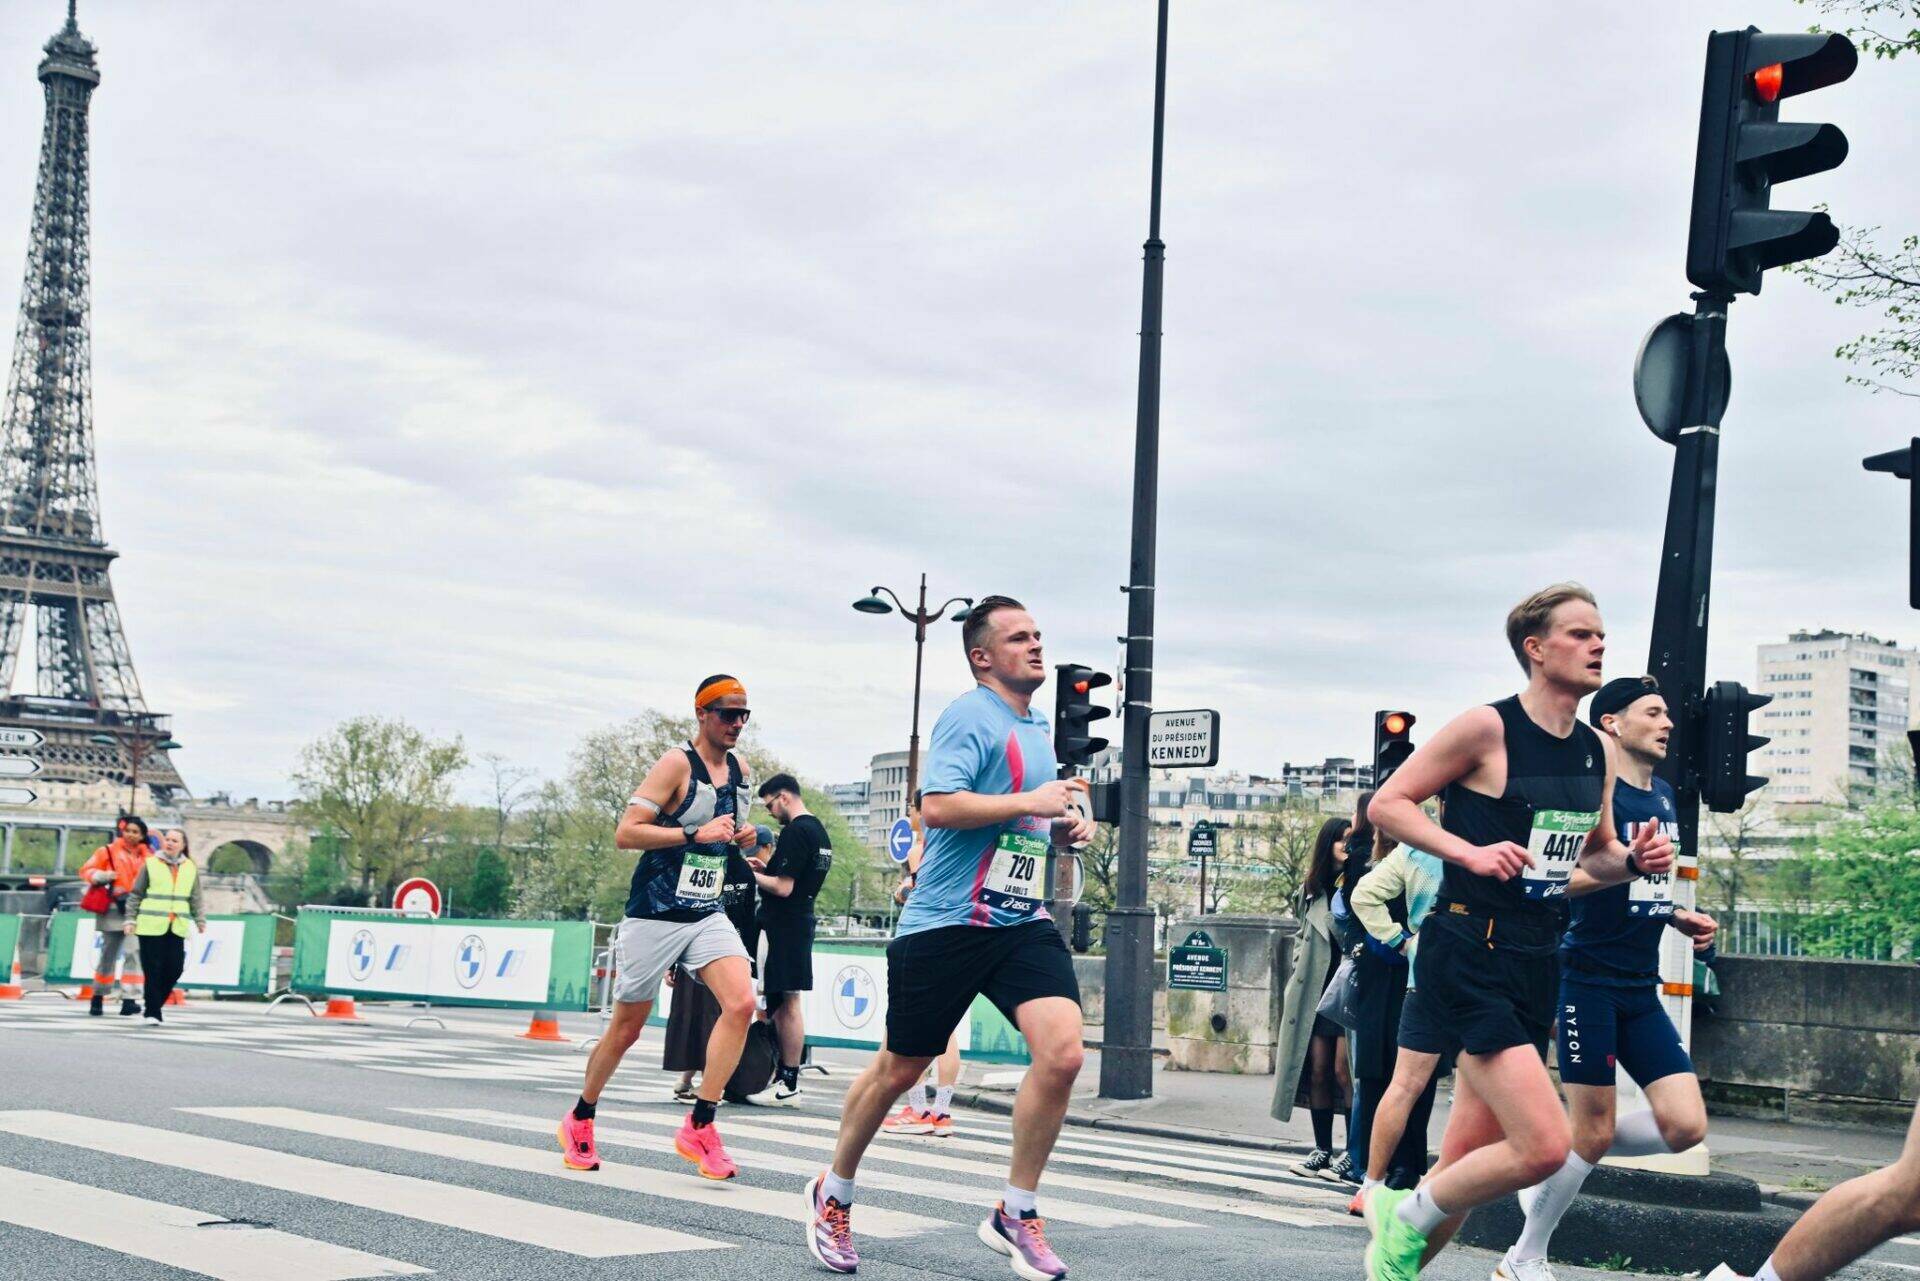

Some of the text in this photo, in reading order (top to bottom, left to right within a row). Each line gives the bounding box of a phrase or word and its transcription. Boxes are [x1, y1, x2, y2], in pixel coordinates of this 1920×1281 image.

[1165, 718, 1196, 727] AVENUE
[1152, 732, 1207, 743] DU PRÉSIDENT
[1151, 745, 1207, 760] KENNEDY
[1008, 854, 1035, 881] 720
[1004, 884, 1012, 893] LA
[1012, 902, 1031, 911] asics
[1186, 954, 1209, 962] AVENUE
[1172, 963, 1199, 972] PRÉSIDENT
[839, 968, 871, 986] BMW
[1565, 1005, 1582, 1063] RYZON
